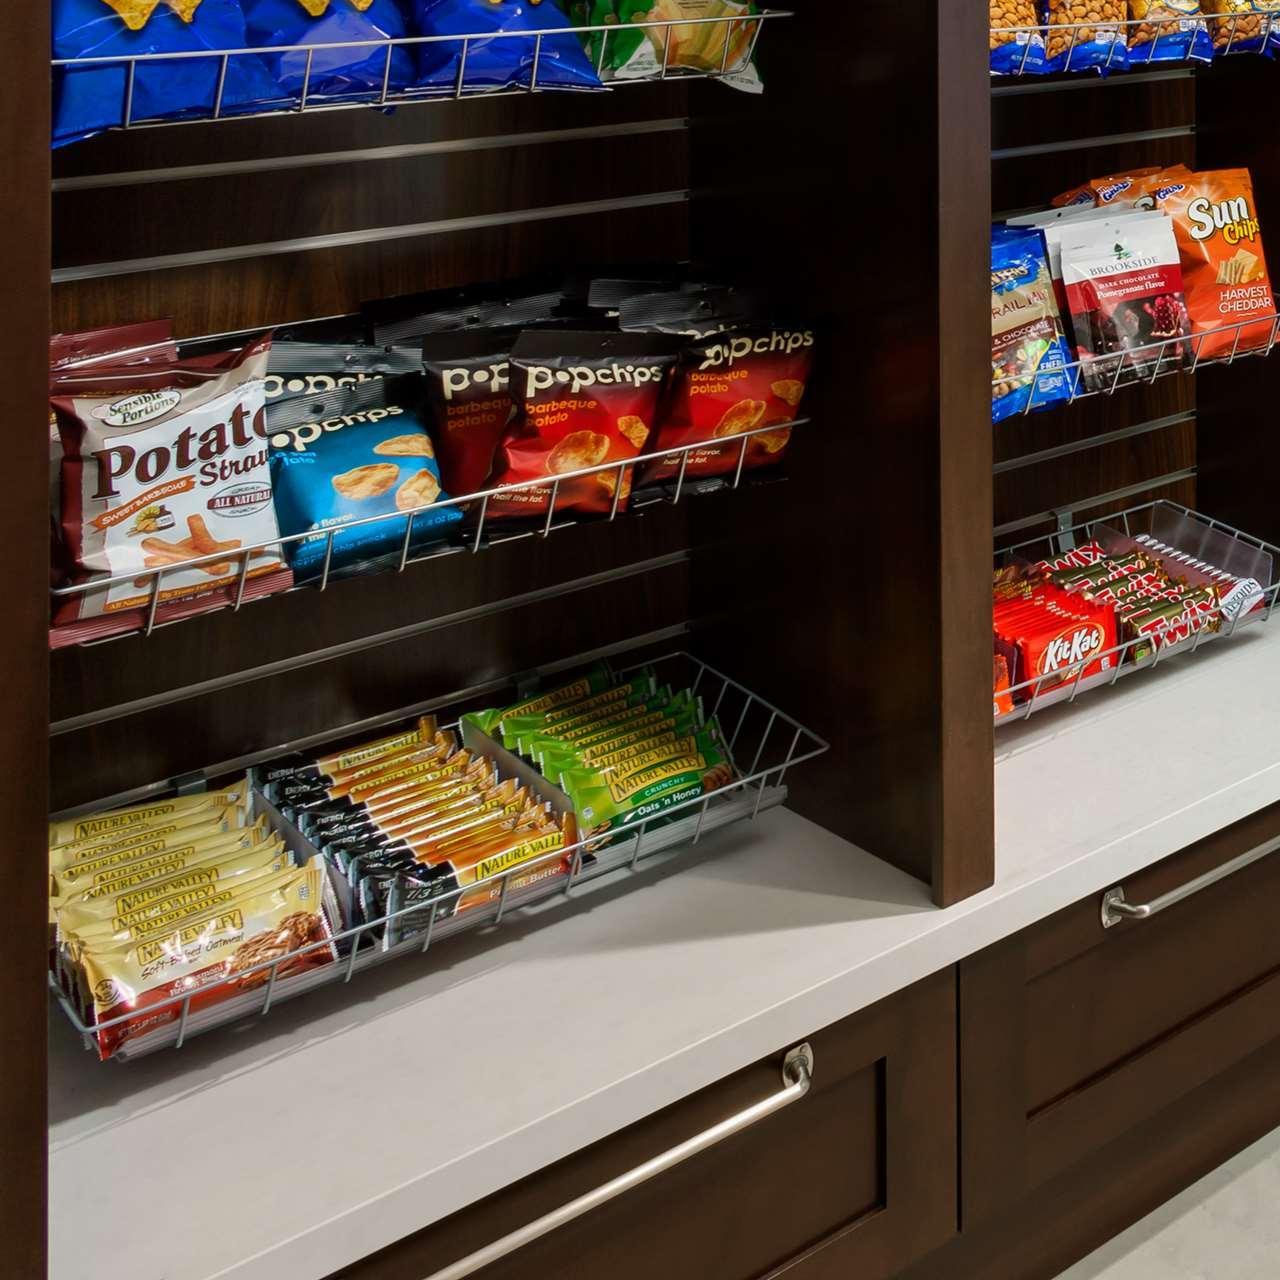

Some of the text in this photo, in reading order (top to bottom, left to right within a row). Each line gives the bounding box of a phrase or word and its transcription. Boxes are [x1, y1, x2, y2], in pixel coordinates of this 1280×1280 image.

[1187, 196, 1250, 241] Sun
[1089, 255, 1160, 276] BROOKSIDE
[1218, 296, 1272, 314] CHEDDAR
[1220, 286, 1268, 302] HARVEST
[991, 298, 1027, 320] RAIL
[526, 363, 663, 398] popchips
[109, 390, 163, 417] Sensible
[121, 396, 177, 425] Portions
[525, 399, 598, 415] barbeque
[271, 405, 404, 451] opchips
[615, 756, 701, 800] NATURE VALLEY
[644, 776, 687, 797] CRUNCHY
[637, 801, 661, 817] Oats
[672, 786, 702, 803] Honey
[481, 832, 564, 874] NATURE VALLE
[121, 885, 170, 911] NATURE
